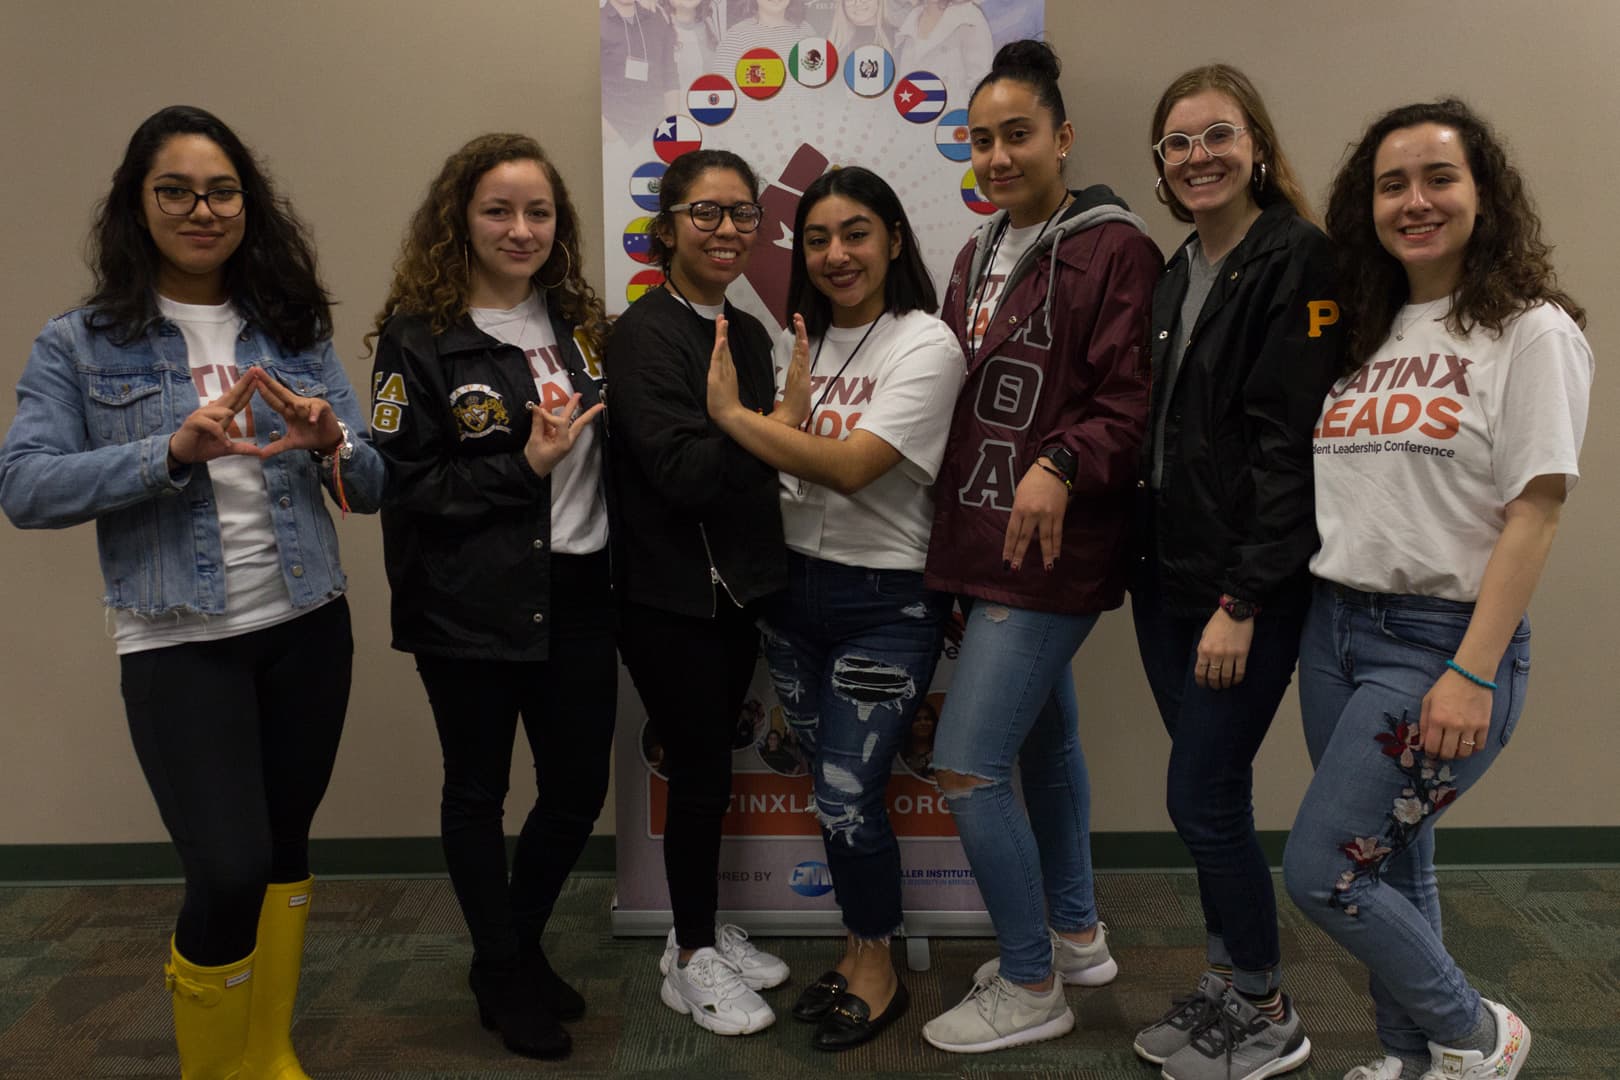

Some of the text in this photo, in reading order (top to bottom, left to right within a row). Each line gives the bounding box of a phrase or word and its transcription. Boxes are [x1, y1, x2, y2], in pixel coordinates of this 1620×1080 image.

[1307, 299, 1340, 338] P
[1328, 353, 1475, 398] ATINX
[1313, 393, 1464, 441] EADS
[1333, 441, 1382, 454] Leadership
[1384, 440, 1456, 459] Conference
[754, 871, 772, 881] BY
